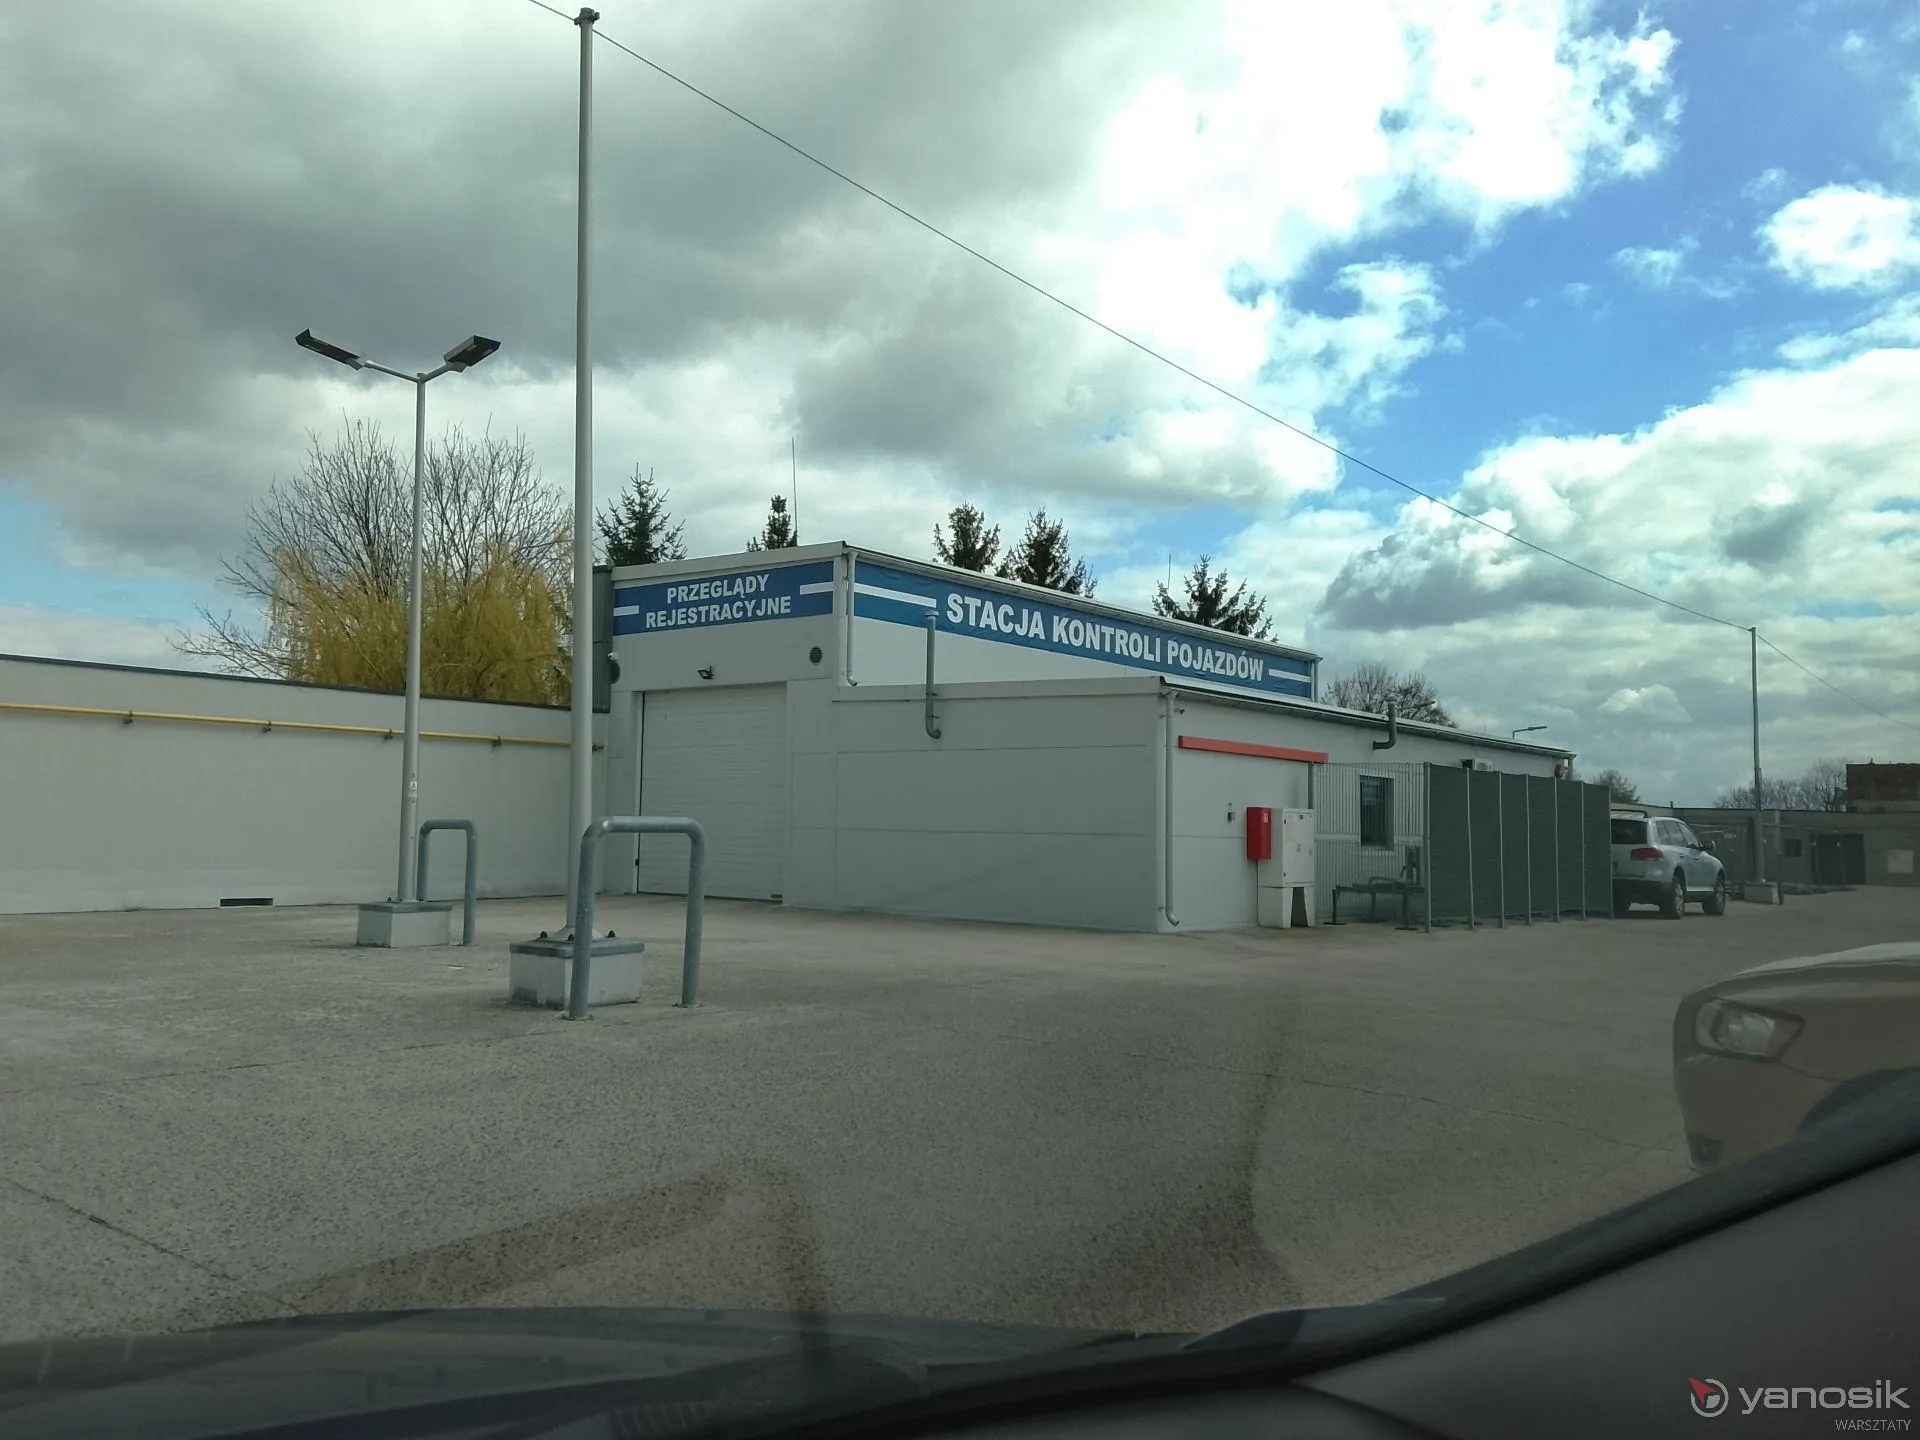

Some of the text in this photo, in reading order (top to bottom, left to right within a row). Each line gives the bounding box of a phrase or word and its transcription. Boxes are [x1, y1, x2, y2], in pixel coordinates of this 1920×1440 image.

[667, 573, 770, 604] PRZEGLĄDY
[645, 595, 792, 628] REJESTRACYJNE
[946, 593, 1264, 682] STACJA KONTROLI POJAZDÓW
